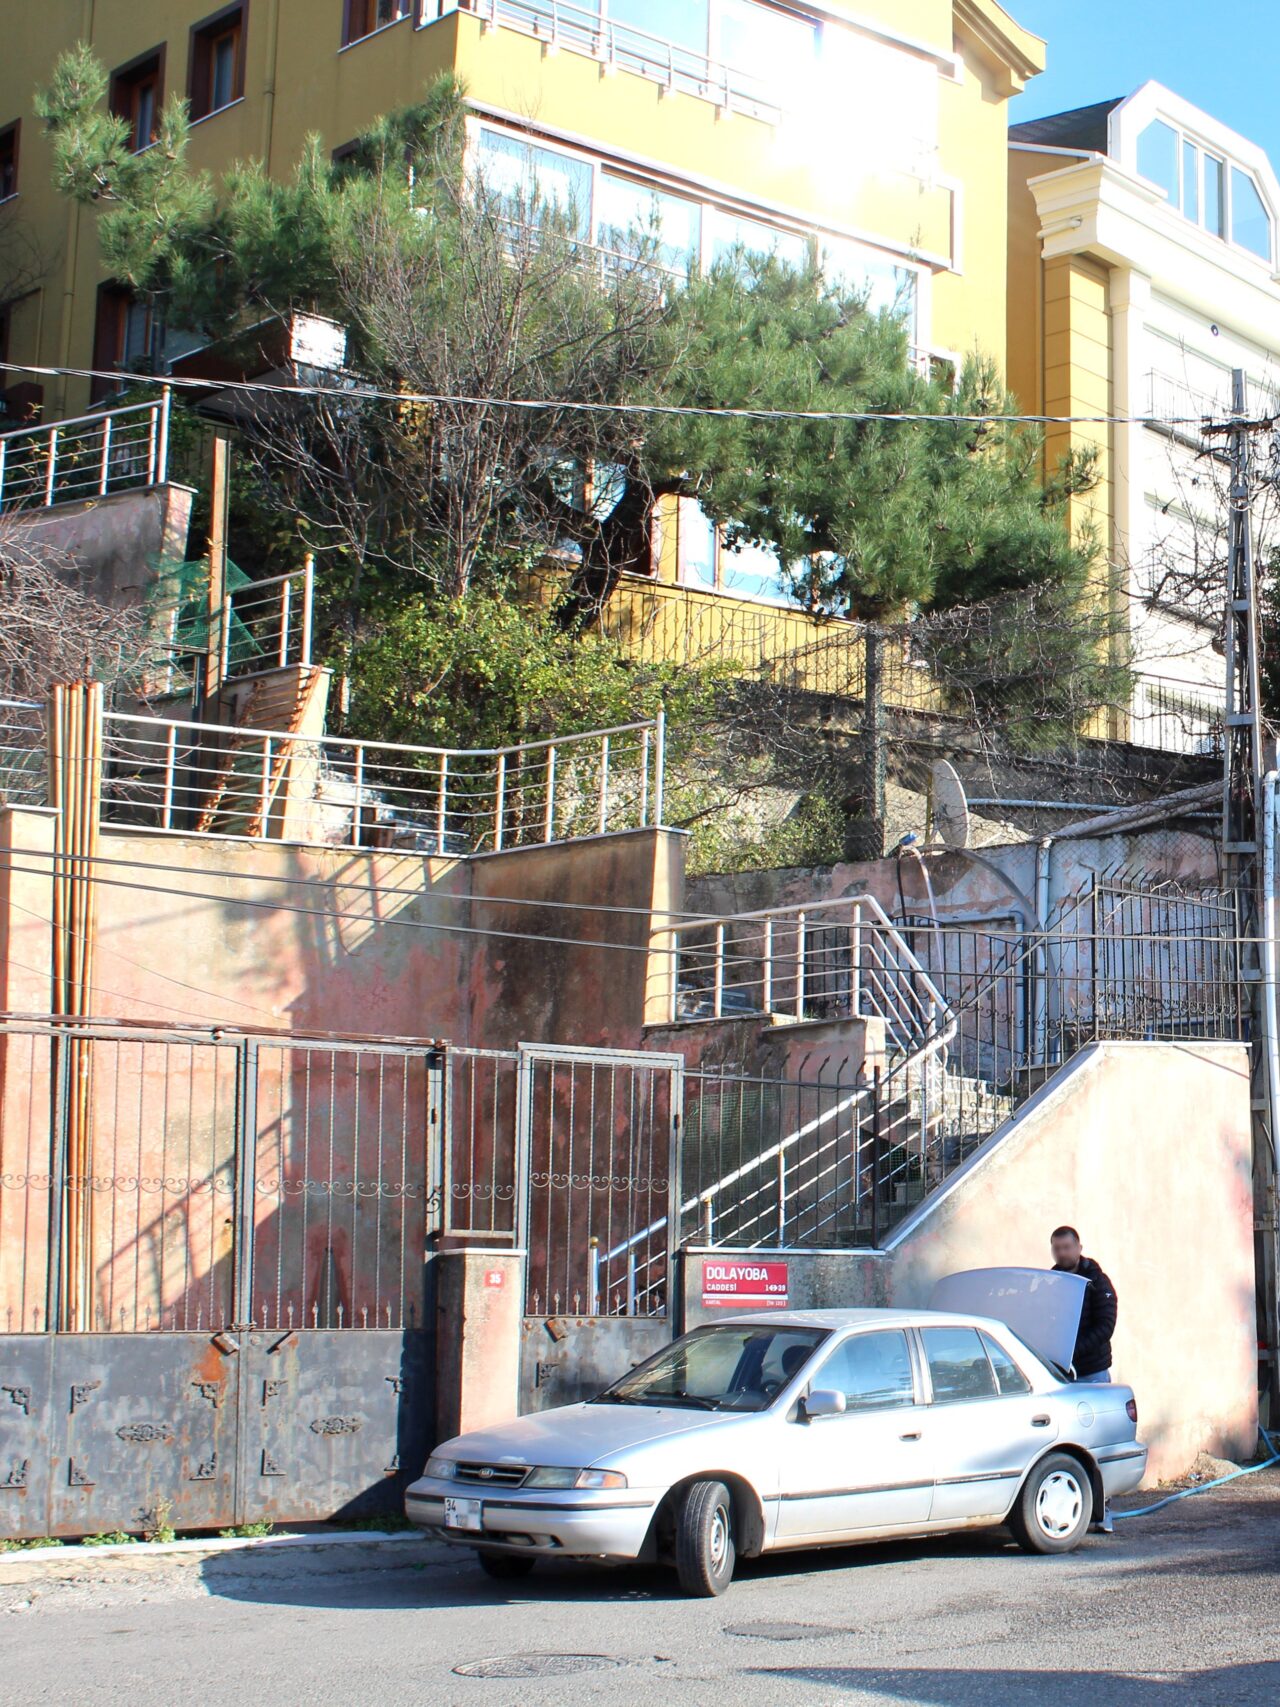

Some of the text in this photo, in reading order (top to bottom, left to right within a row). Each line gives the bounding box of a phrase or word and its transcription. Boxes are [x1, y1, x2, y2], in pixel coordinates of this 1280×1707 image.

[490, 1273, 501, 1283] 35
[706, 1266, 768, 1281] DOLAYOBA
[706, 1283, 737, 1292] CADDESİ
[446, 1499, 456, 1512] 34
